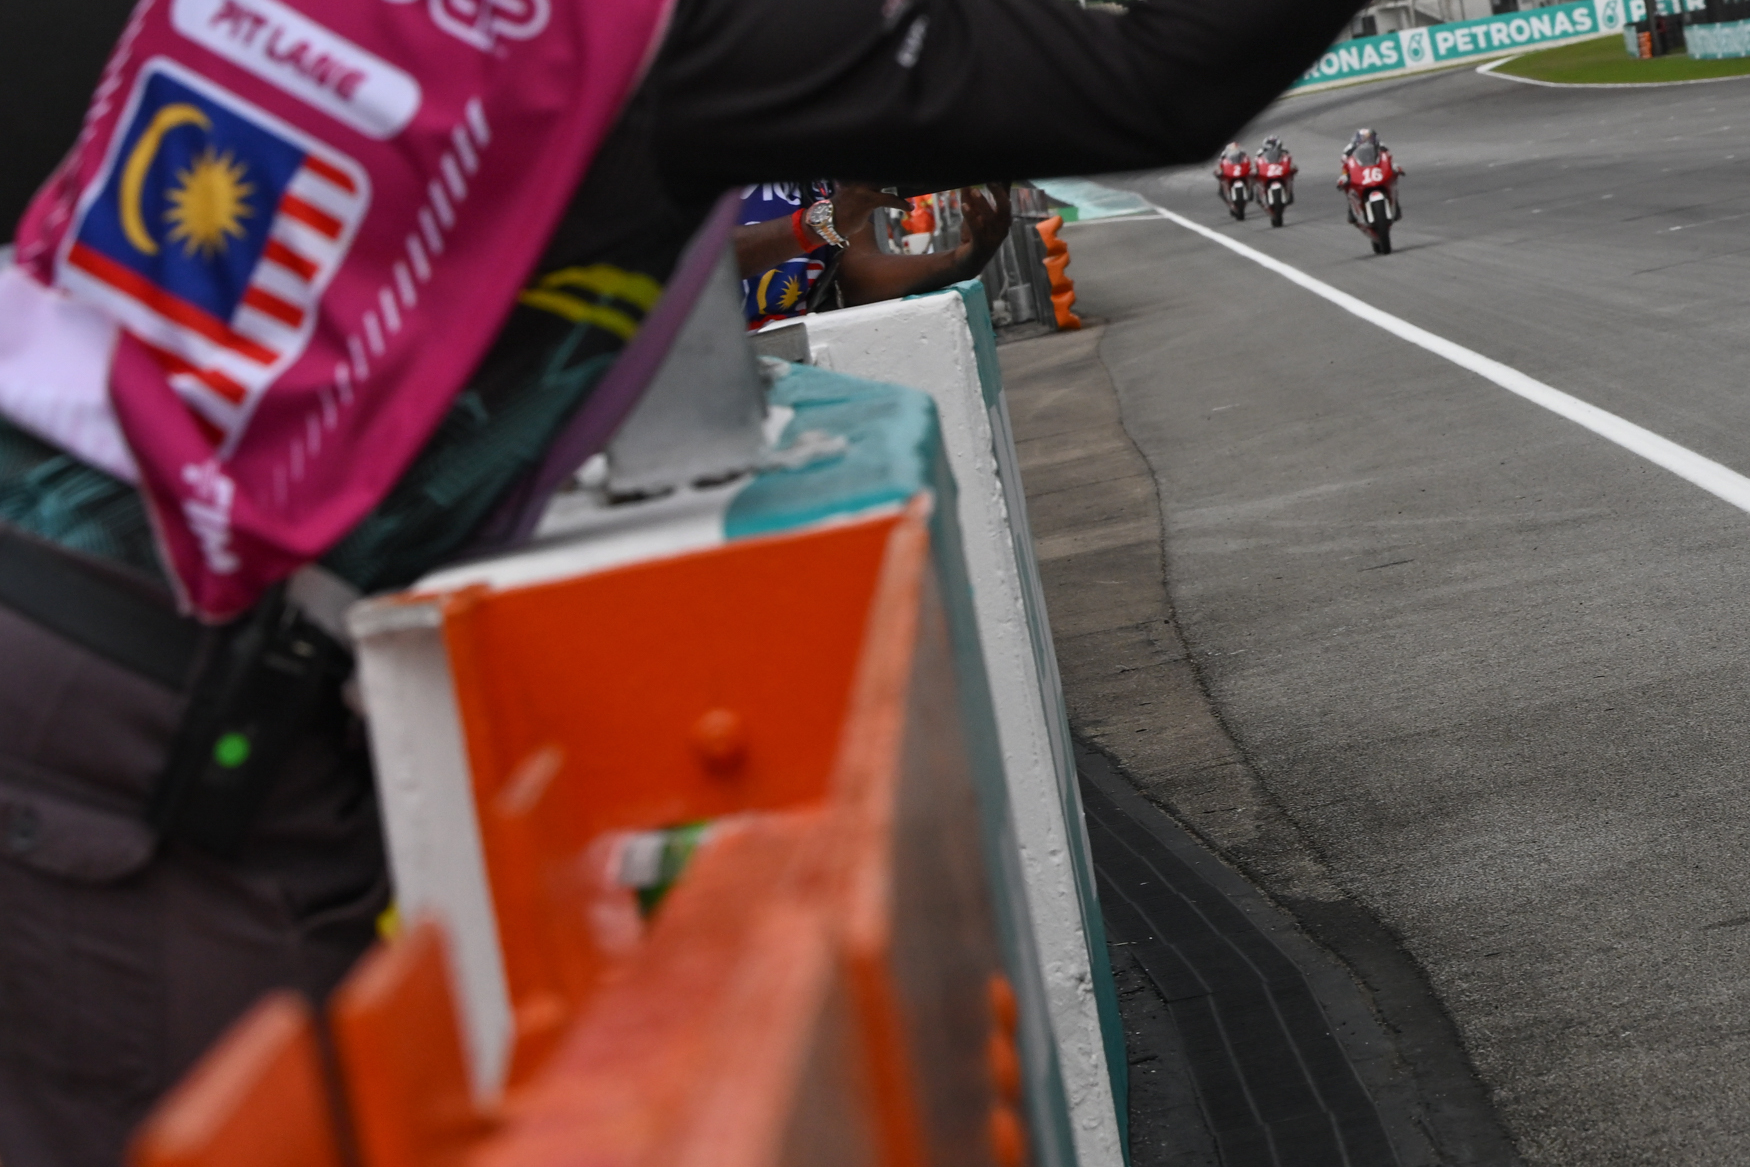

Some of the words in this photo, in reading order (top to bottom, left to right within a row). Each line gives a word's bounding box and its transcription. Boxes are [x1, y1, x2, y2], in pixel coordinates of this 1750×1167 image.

[1435, 6, 1593, 56] PETRONAS
[264, 26, 369, 104] LANE
[1304, 40, 1399, 81] RONAS
[1233, 165, 1242, 177] 2
[1266, 164, 1284, 177] 22
[1361, 167, 1384, 186] 16
